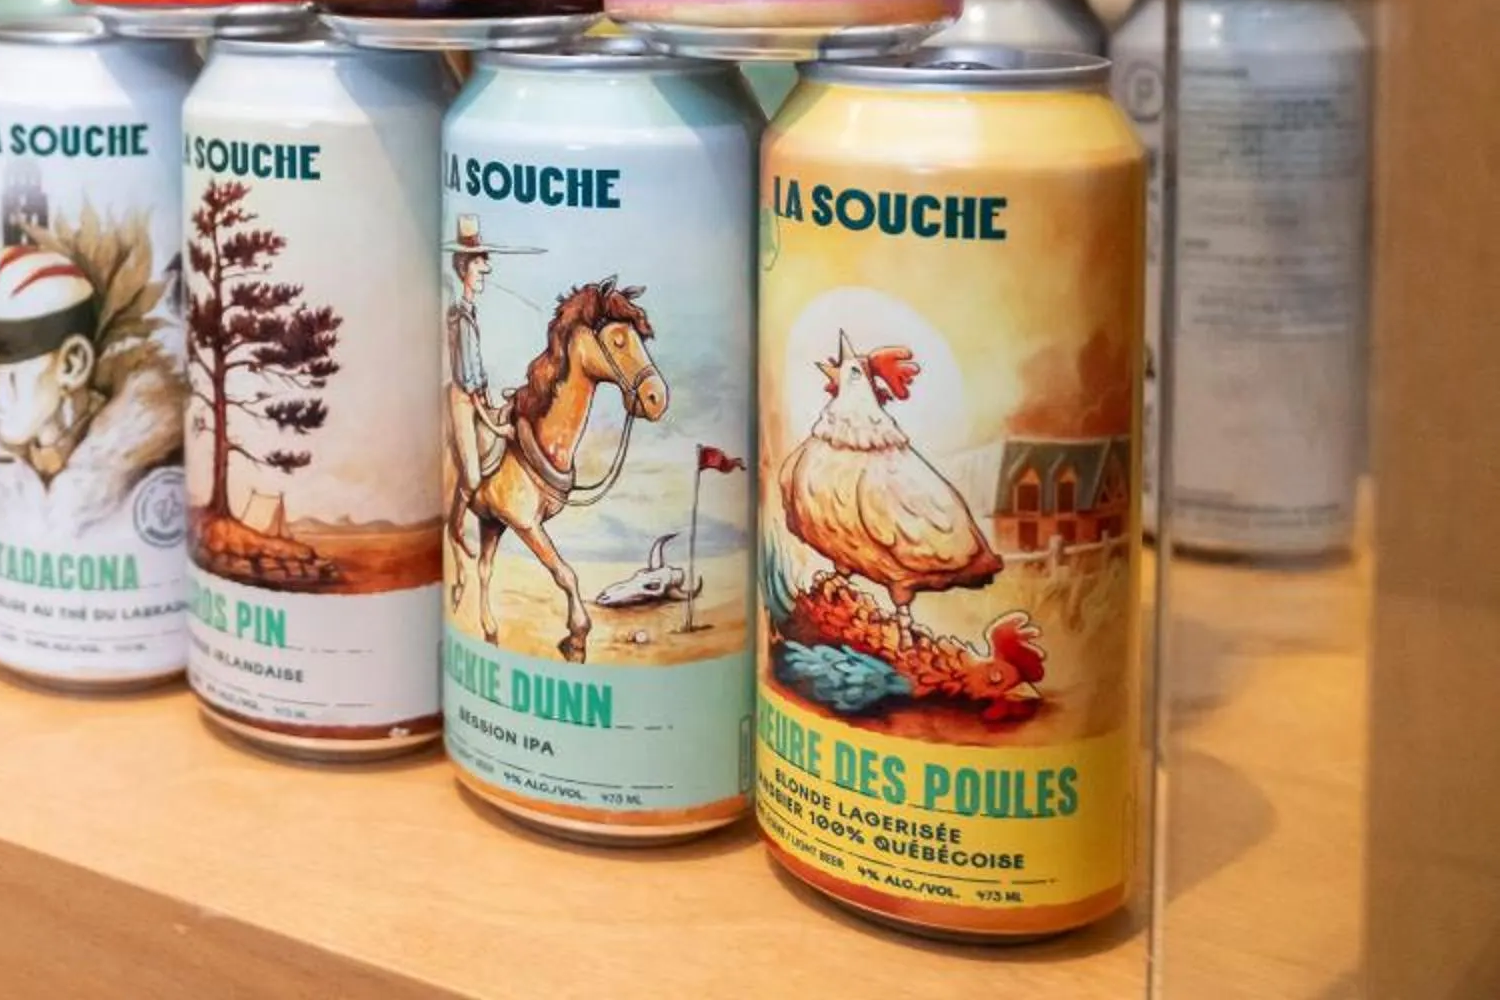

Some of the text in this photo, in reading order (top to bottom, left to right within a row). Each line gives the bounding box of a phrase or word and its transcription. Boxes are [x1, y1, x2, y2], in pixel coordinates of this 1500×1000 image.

[10, 124, 148, 158] SOUCHE
[195, 135, 321, 181] SOUCHE
[444, 152, 621, 208] LA SOUCHE
[773, 175, 1008, 240] LA SOUCHE
[235, 600, 285, 648] PIN
[511, 667, 613, 729] DUNN
[459, 705, 518, 745] SESSION
[522, 735, 555, 756] IPA
[775, 768, 830, 811] BLONDE
[838, 801, 962, 845] LAGERISÉE
[834, 740, 907, 805] DES
[923, 763, 1079, 819] POULES
[809, 811, 865, 845] 100%
[872, 836, 1025, 870] QUÉBÉCOISE
